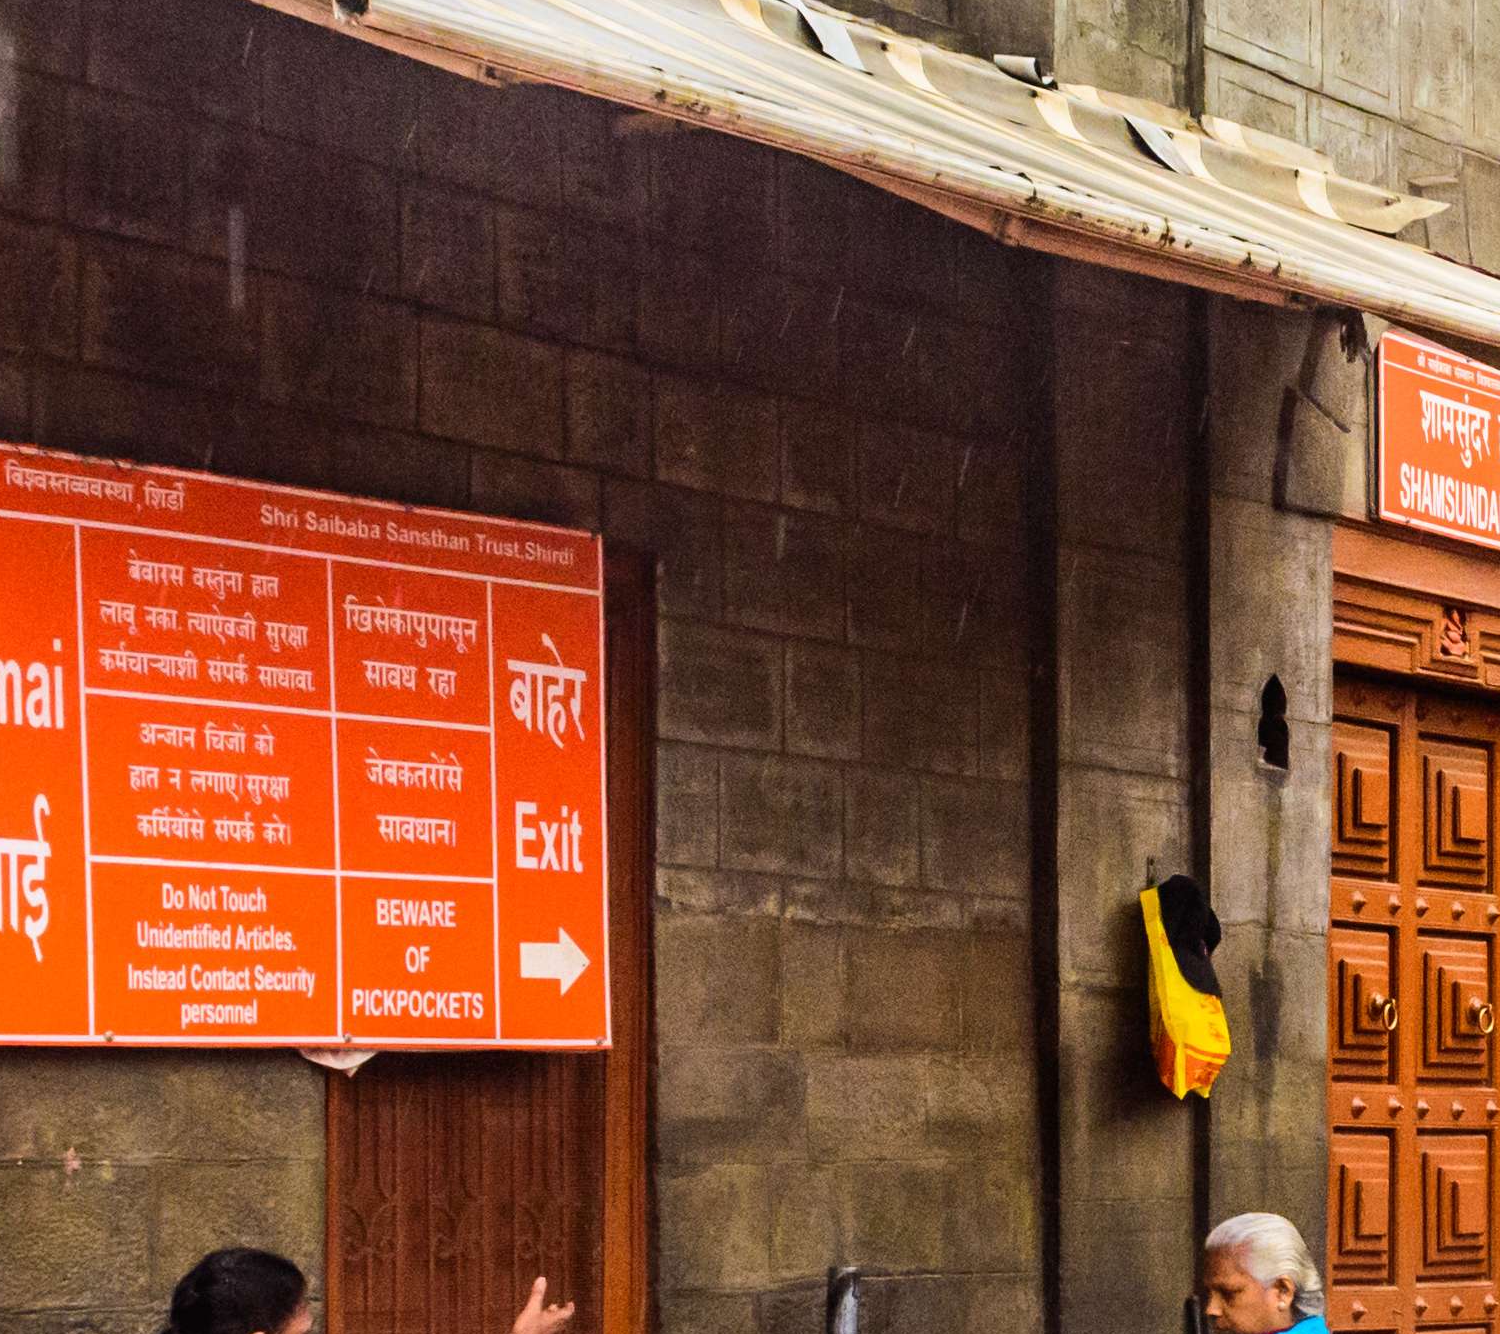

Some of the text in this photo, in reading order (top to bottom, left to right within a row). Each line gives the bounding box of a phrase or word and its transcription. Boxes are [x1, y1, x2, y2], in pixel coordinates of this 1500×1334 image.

[260, 504, 299, 529] Shri
[305, 510, 381, 539] Saibaba
[386, 522, 470, 552] Sansthan
[127, 548, 184, 587] बेवारस
[251, 573, 279, 598] हात
[264, 621, 309, 653] सुरक्षा
[207, 653, 249, 684] संपर्क
[426, 667, 457, 699] रहा
[506, 633, 587, 749] बाहेर
[140, 722, 196, 749] अन्जान
[254, 724, 274, 756] को
[128, 764, 160, 791] हात
[168, 769, 182, 791] न
[214, 811, 255, 844] संपर्क
[515, 800, 584, 873] Exit
[162, 883, 267, 912] Do Not Touch
[376, 898, 456, 928] BEWARE
[137, 921, 297, 951] Unidentified Articles.
[405, 946, 431, 973] OF
[128, 964, 316, 997] Instead Contact Security
[181, 1000, 257, 1029] personnel
[352, 988, 484, 1019] PICKPOCKETS
